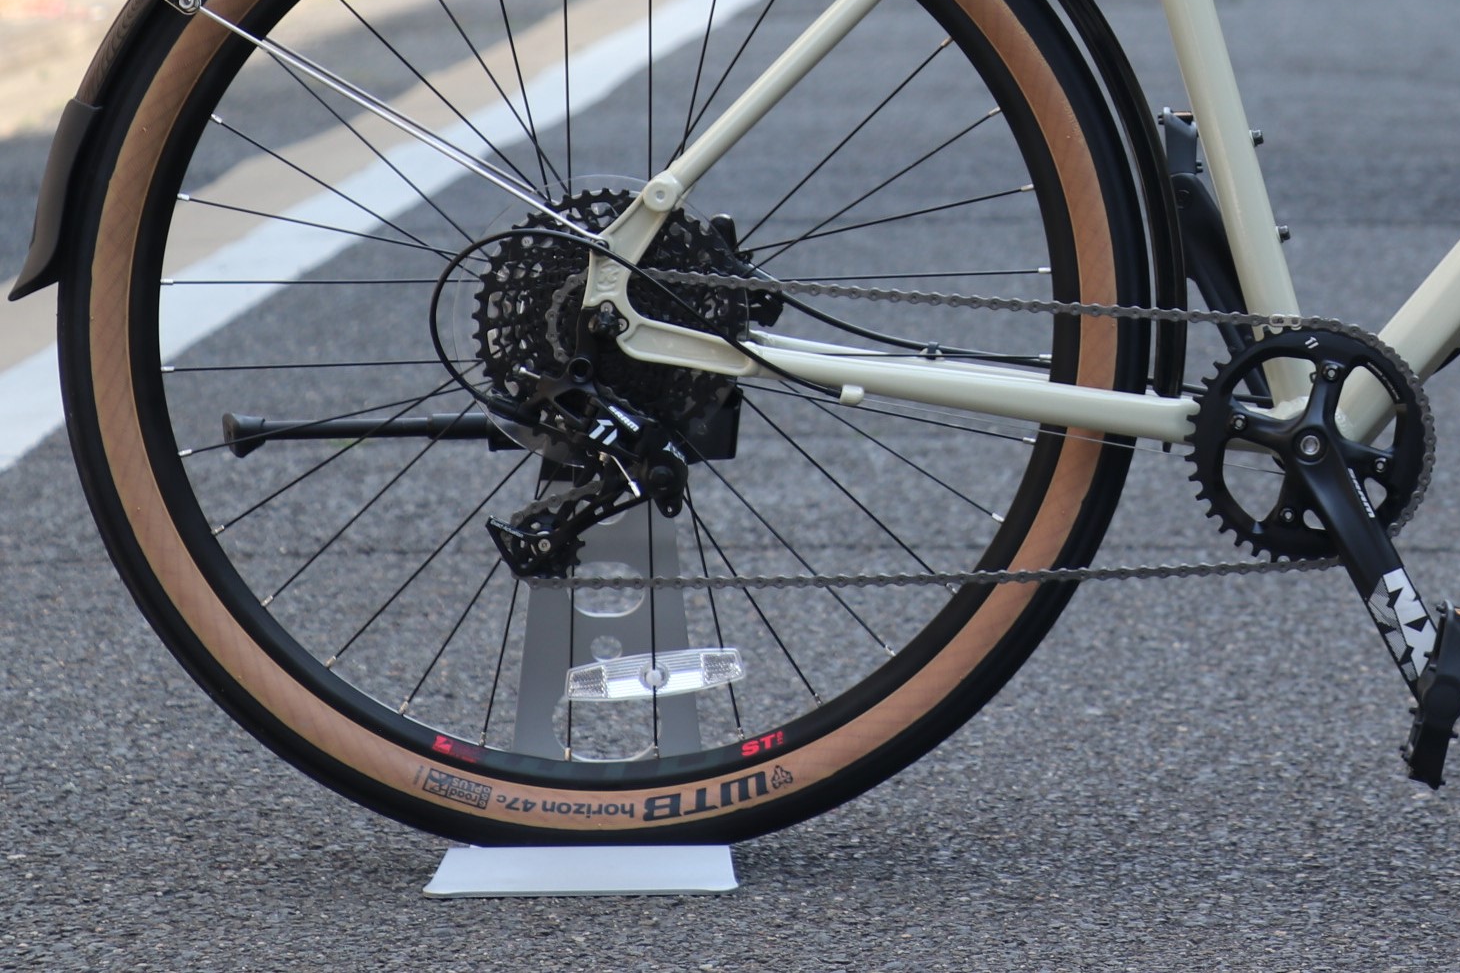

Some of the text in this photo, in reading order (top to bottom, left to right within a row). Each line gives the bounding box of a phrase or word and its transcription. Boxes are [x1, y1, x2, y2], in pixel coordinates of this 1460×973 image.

[450, 787, 478, 802] road
[496, 771, 770, 821] WTB horizon 47c
